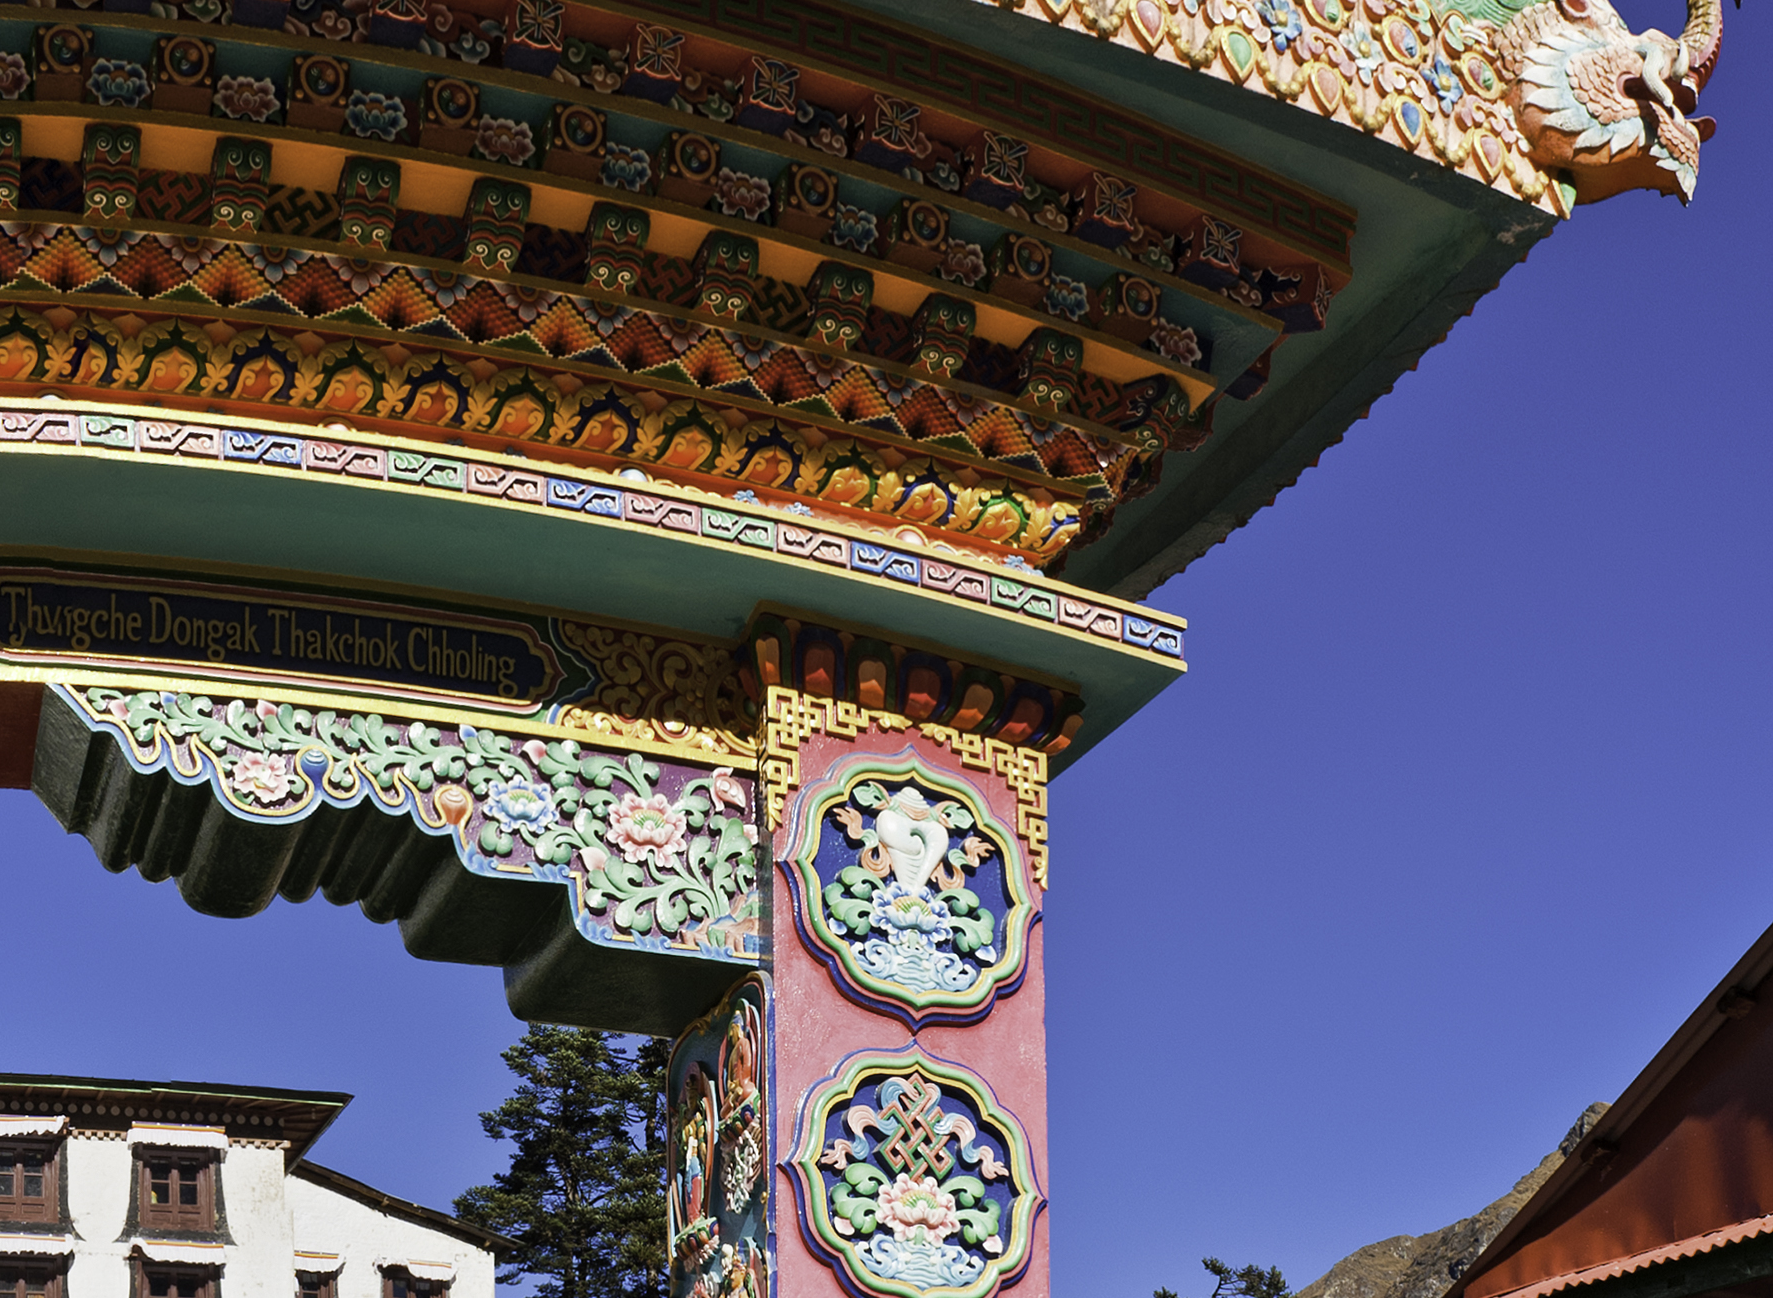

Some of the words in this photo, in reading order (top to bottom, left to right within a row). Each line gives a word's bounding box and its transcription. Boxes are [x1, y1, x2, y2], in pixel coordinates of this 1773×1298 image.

[151, 598, 261, 662] Dongak
[268, 610, 402, 669] Thakchok
[408, 628, 518, 698] Chholing
